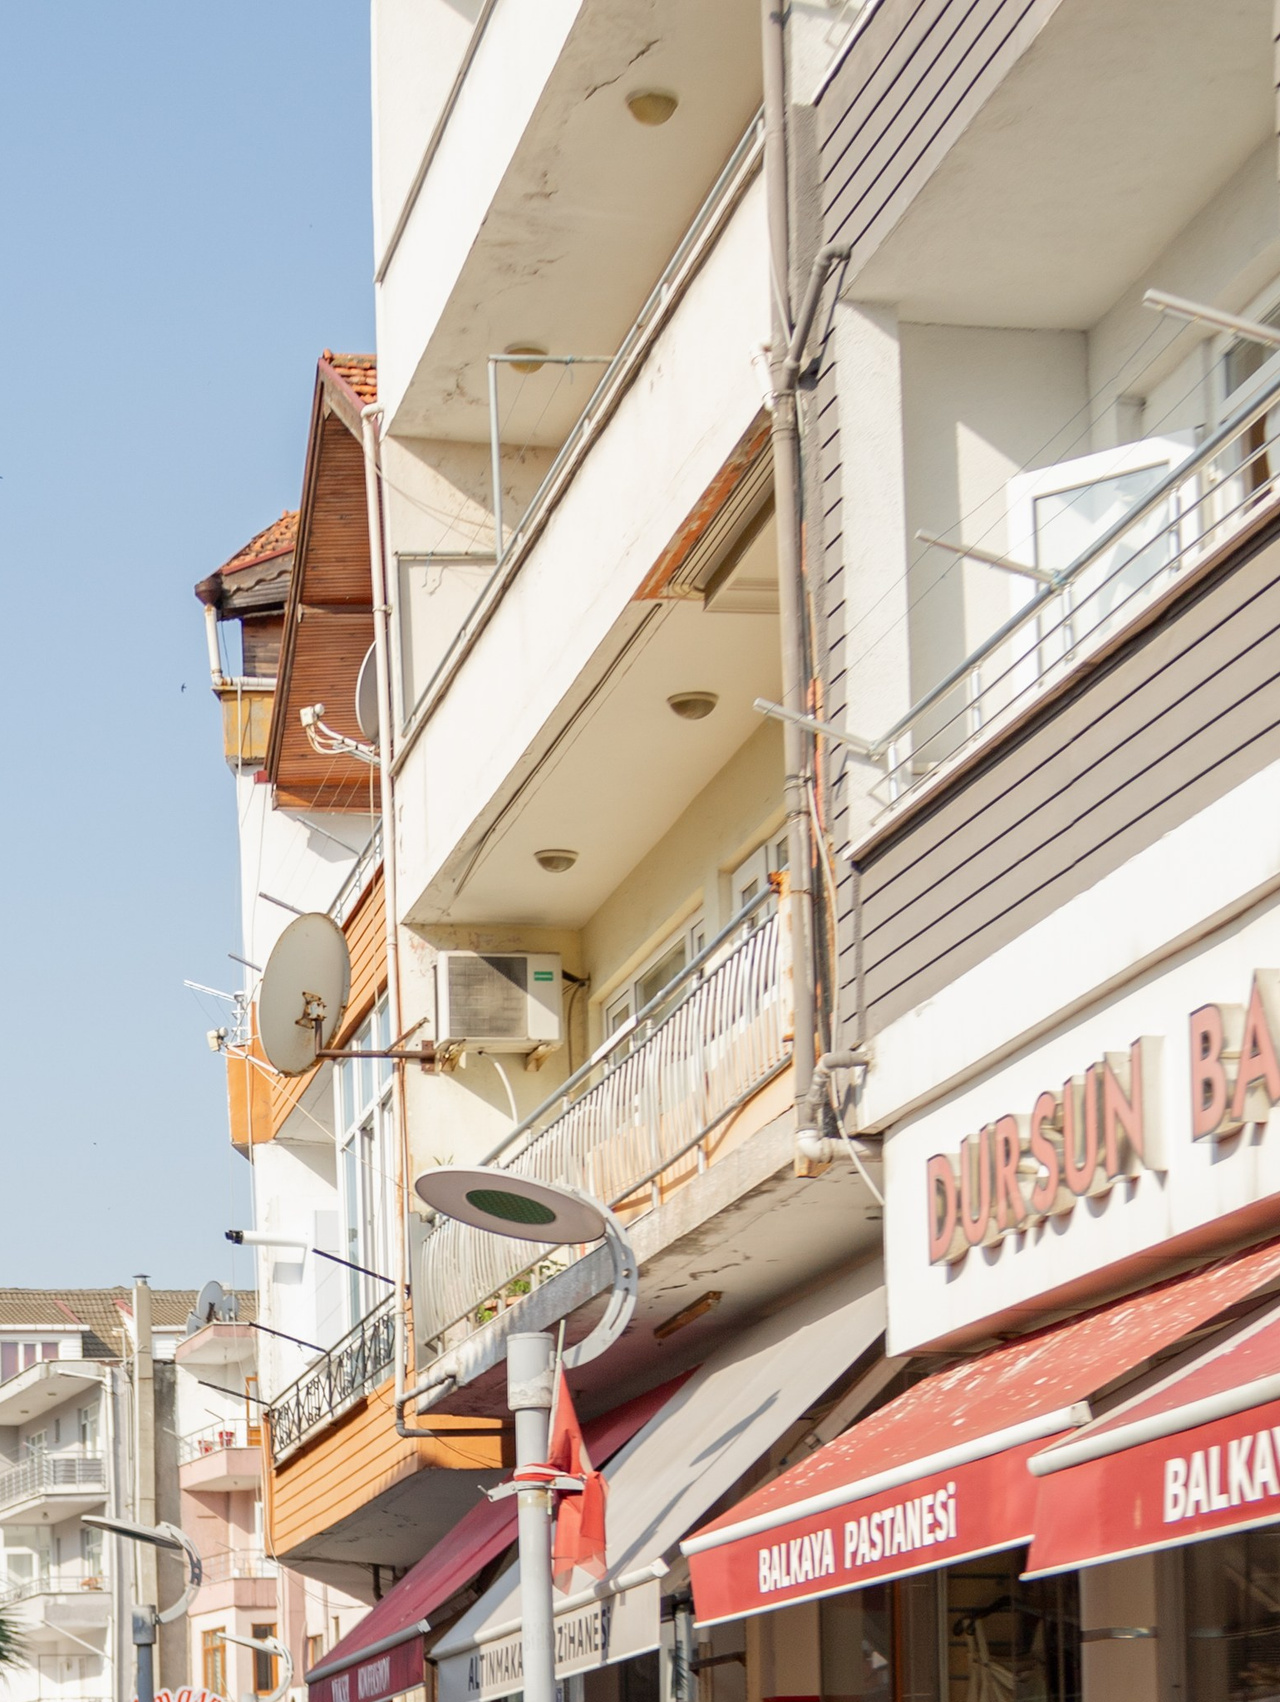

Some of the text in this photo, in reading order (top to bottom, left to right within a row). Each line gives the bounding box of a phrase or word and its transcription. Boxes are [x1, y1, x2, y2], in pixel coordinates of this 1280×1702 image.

[927, 1036, 1156, 1266] DURSUN
[758, 1528, 834, 1594] BALKAYA
[468, 1642, 525, 1692] ALTINMAKA
